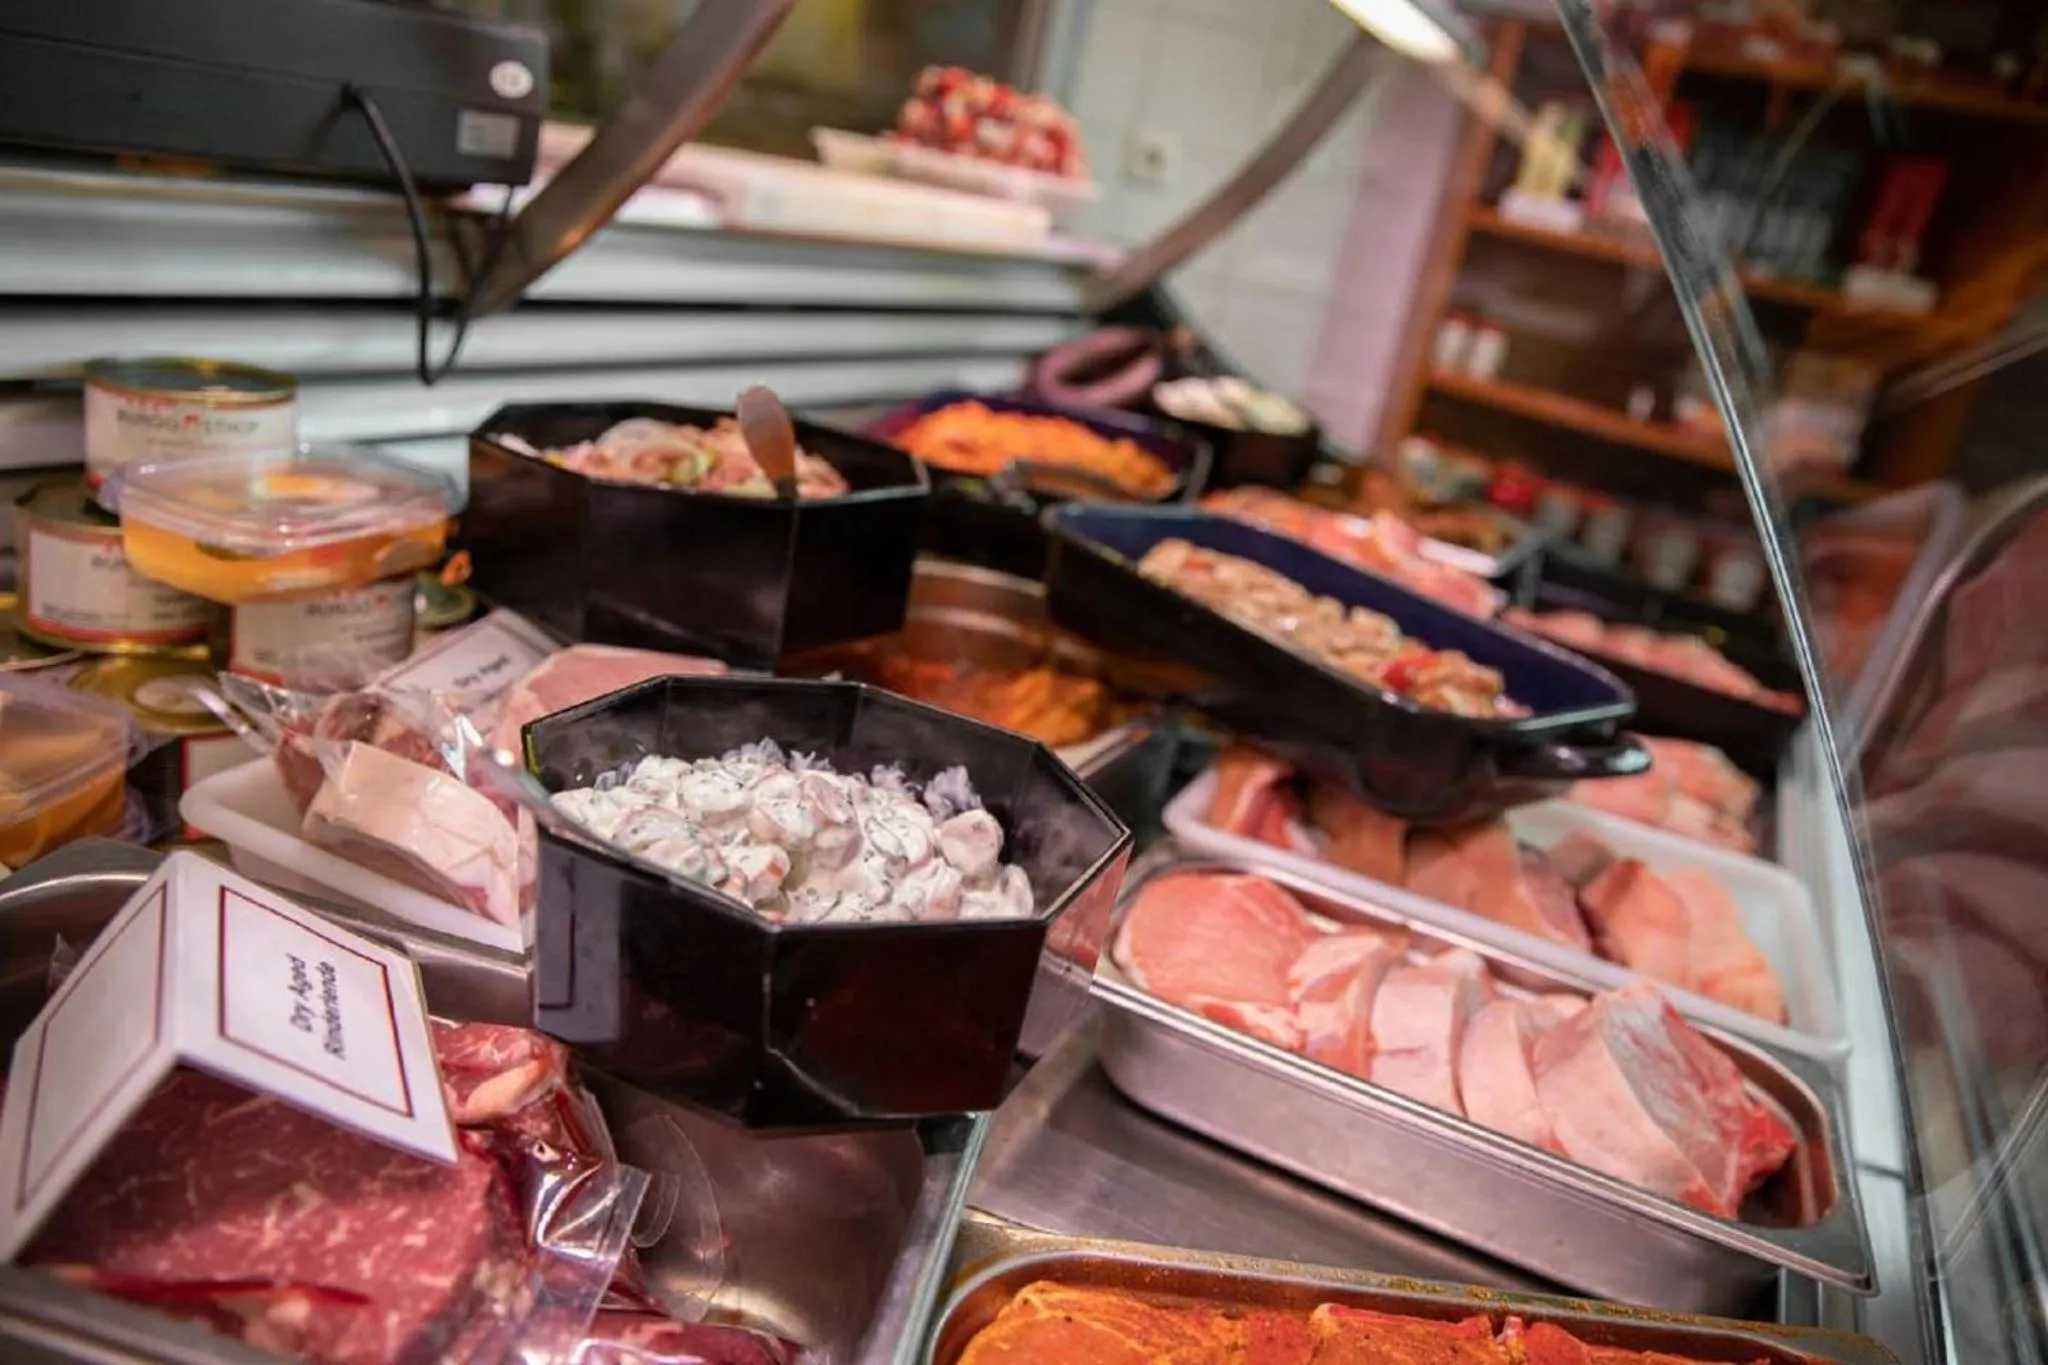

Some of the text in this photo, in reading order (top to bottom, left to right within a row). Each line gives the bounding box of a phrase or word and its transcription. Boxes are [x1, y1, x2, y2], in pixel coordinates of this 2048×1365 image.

[286, 953, 316, 1033] Dry Aged
[315, 961, 346, 1060] Rinderlende
